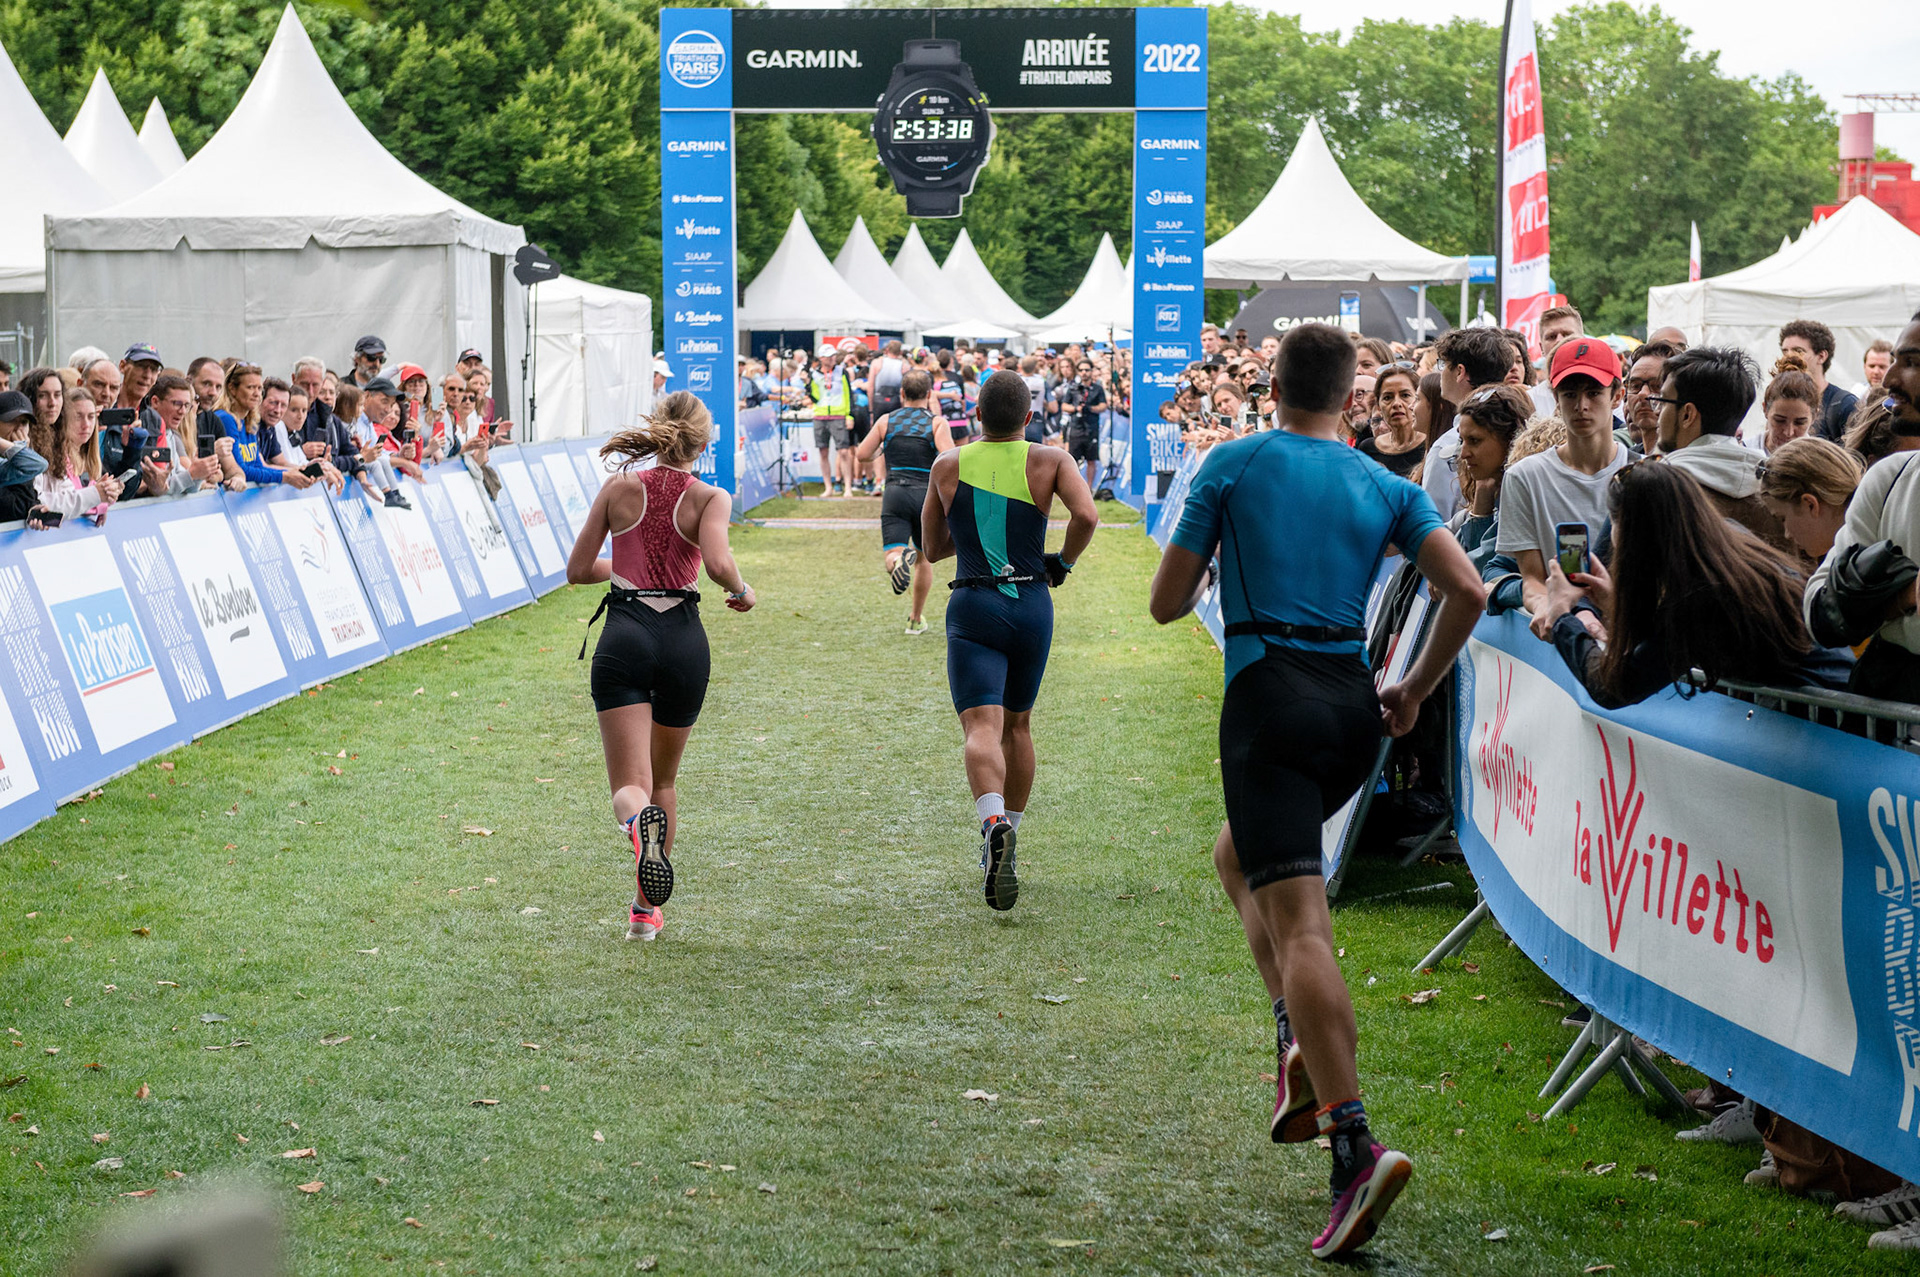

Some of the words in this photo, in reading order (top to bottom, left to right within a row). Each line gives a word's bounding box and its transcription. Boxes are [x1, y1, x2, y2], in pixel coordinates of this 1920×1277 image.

[1021, 33, 1110, 66] ARRIVÉE
[1143, 43, 1201, 73] 2022
[673, 62, 719, 74] PARIS
[1019, 70, 1113, 85] #TRIATHLONPARIS
[893, 120, 973, 139] 2:53:38
[1163, 194, 1194, 204] PARIS
[1156, 221, 1183, 230] SIAAP
[692, 286, 722, 296] PARIS
[1149, 440, 1183, 457] BIKE
[236, 511, 283, 564] SWIM
[123, 535, 176, 595] SWIM
[204, 573, 257, 624] Bonbon
[278, 606, 316, 662] RUN
[331, 619, 366, 644] TRIATHLON
[169, 641, 212, 703] RUN
[30, 689, 82, 762] RUN
[1487, 654, 1538, 843] Villette
[1574, 800, 1592, 886] la
[1596, 722, 1775, 964] Villette
